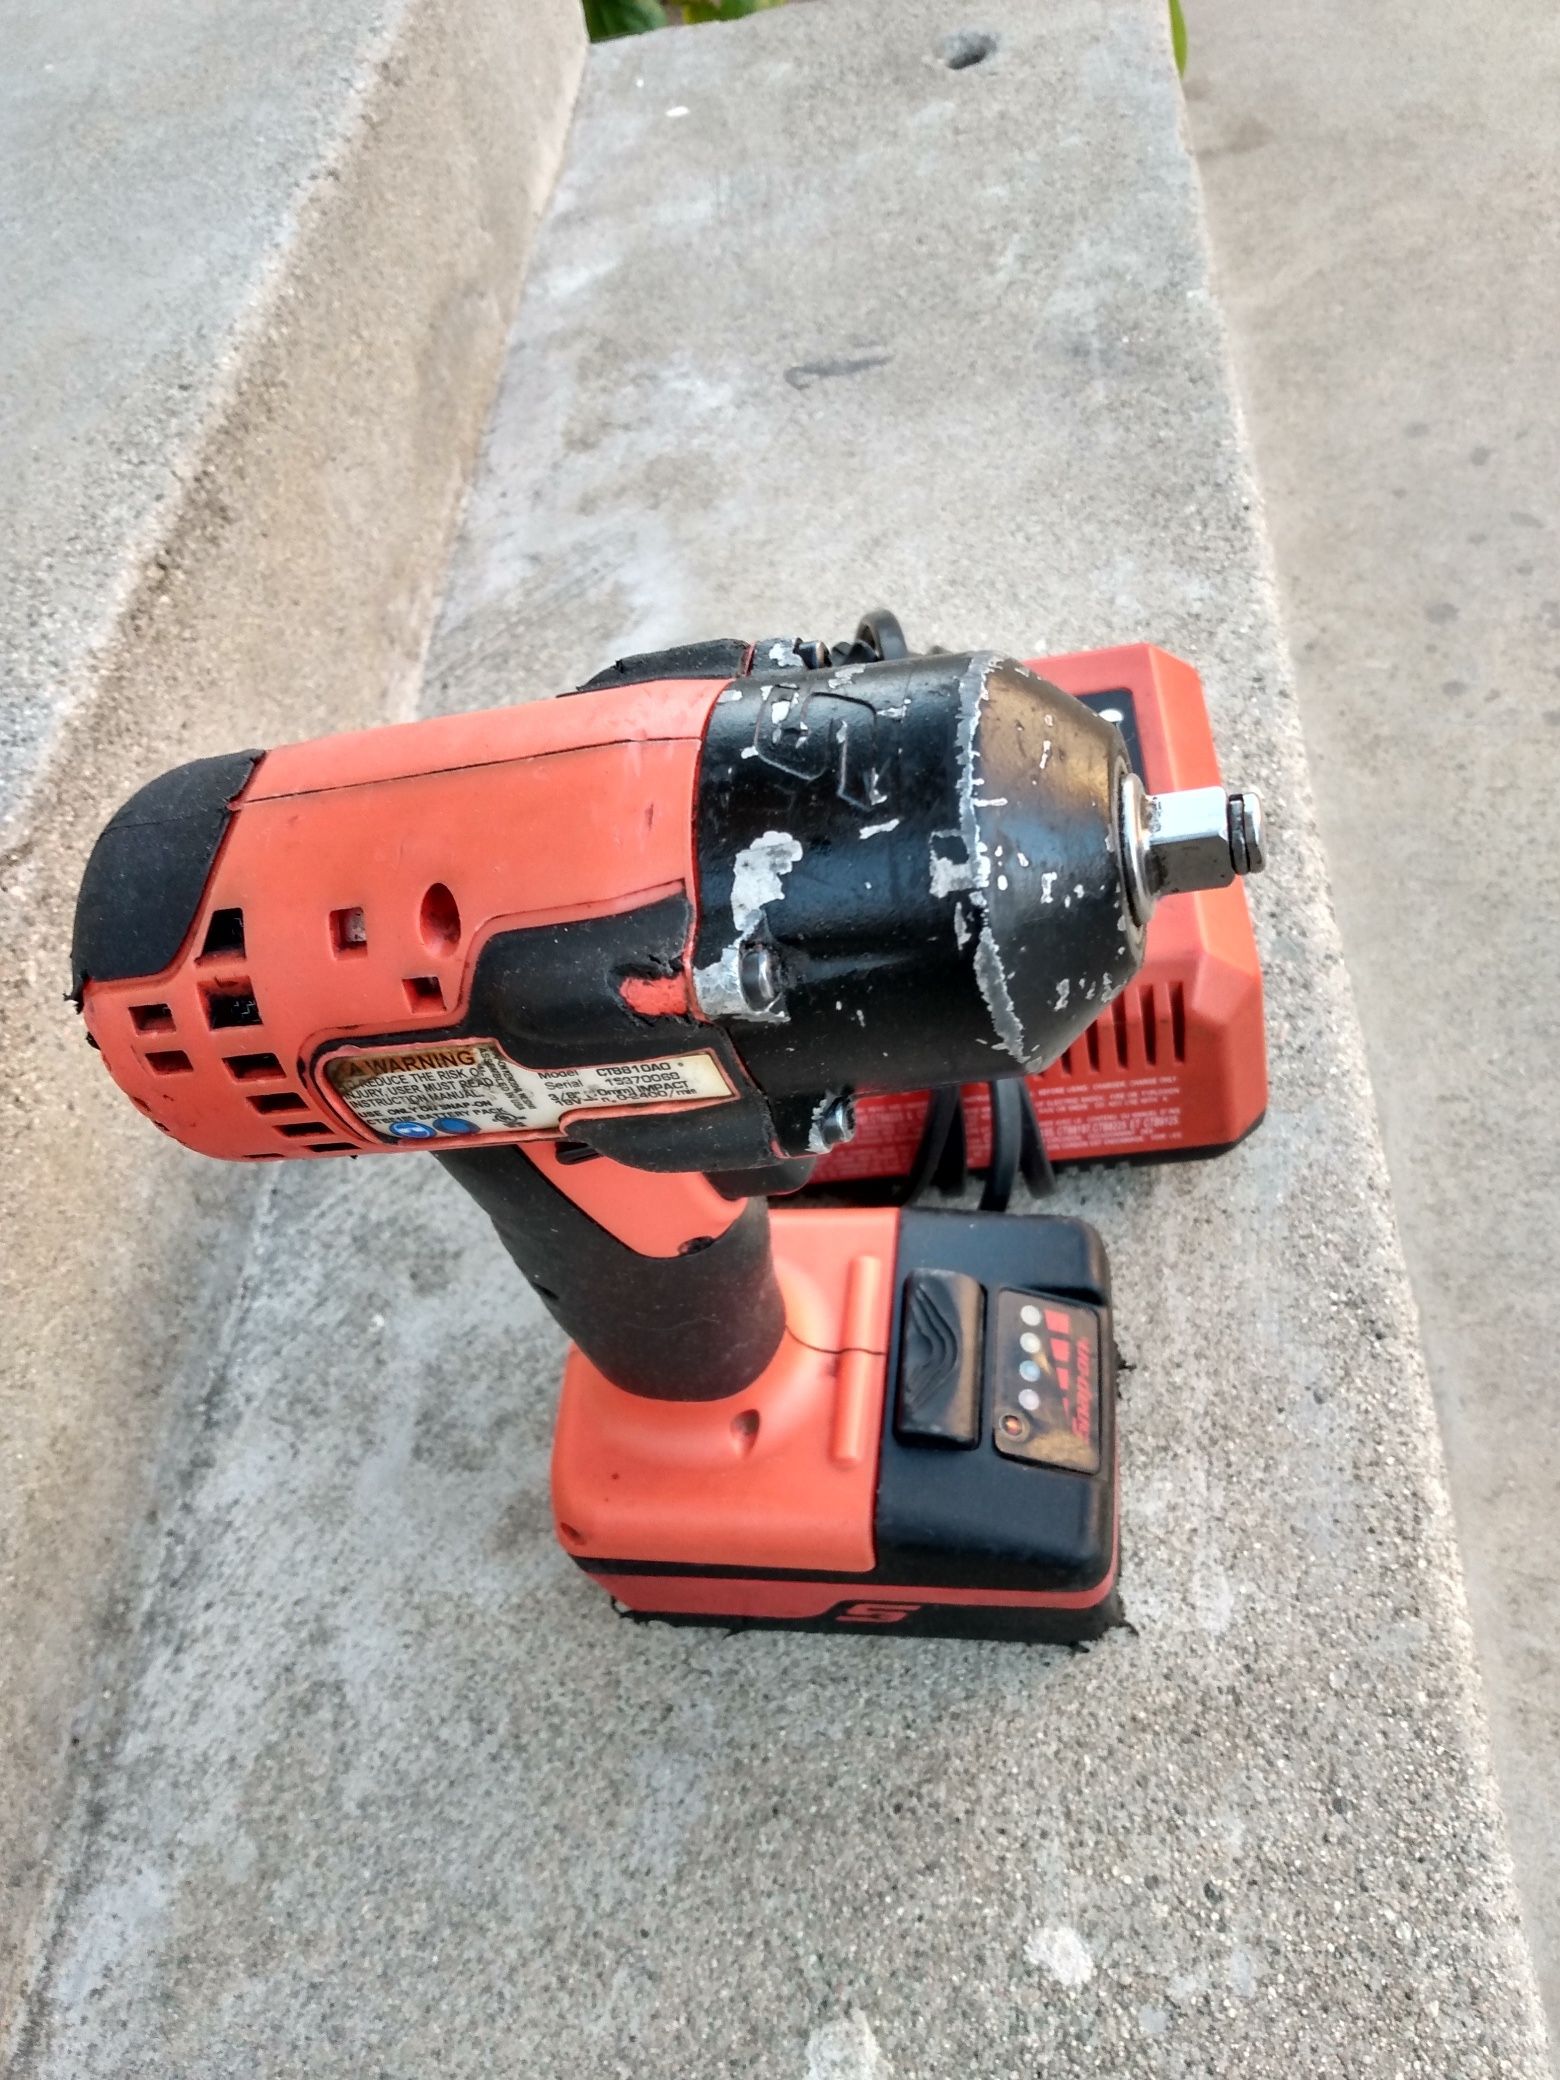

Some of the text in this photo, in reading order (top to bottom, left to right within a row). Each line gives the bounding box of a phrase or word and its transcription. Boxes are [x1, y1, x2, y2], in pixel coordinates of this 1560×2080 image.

[364, 1050, 475, 1075] WARNING
[359, 1074, 408, 1088] REDUCE
[409, 1071, 434, 1084] THE
[437, 1068, 468, 1081] RISK
[538, 1069, 581, 1080] Model
[387, 1084, 420, 1097] USER
[423, 1081, 457, 1093] MUST
[459, 1077, 494, 1089] READ
[543, 1079, 584, 1091] Serial
[638, 1080, 690, 1093] IMPACT
[348, 1095, 428, 1110] INSTRUCTION
[358, 1100, 493, 1119] USE ONLY ON SNAP-ON
[416, 1109, 470, 1121] BATTERY
[471, 1106, 507, 1116] PACK
